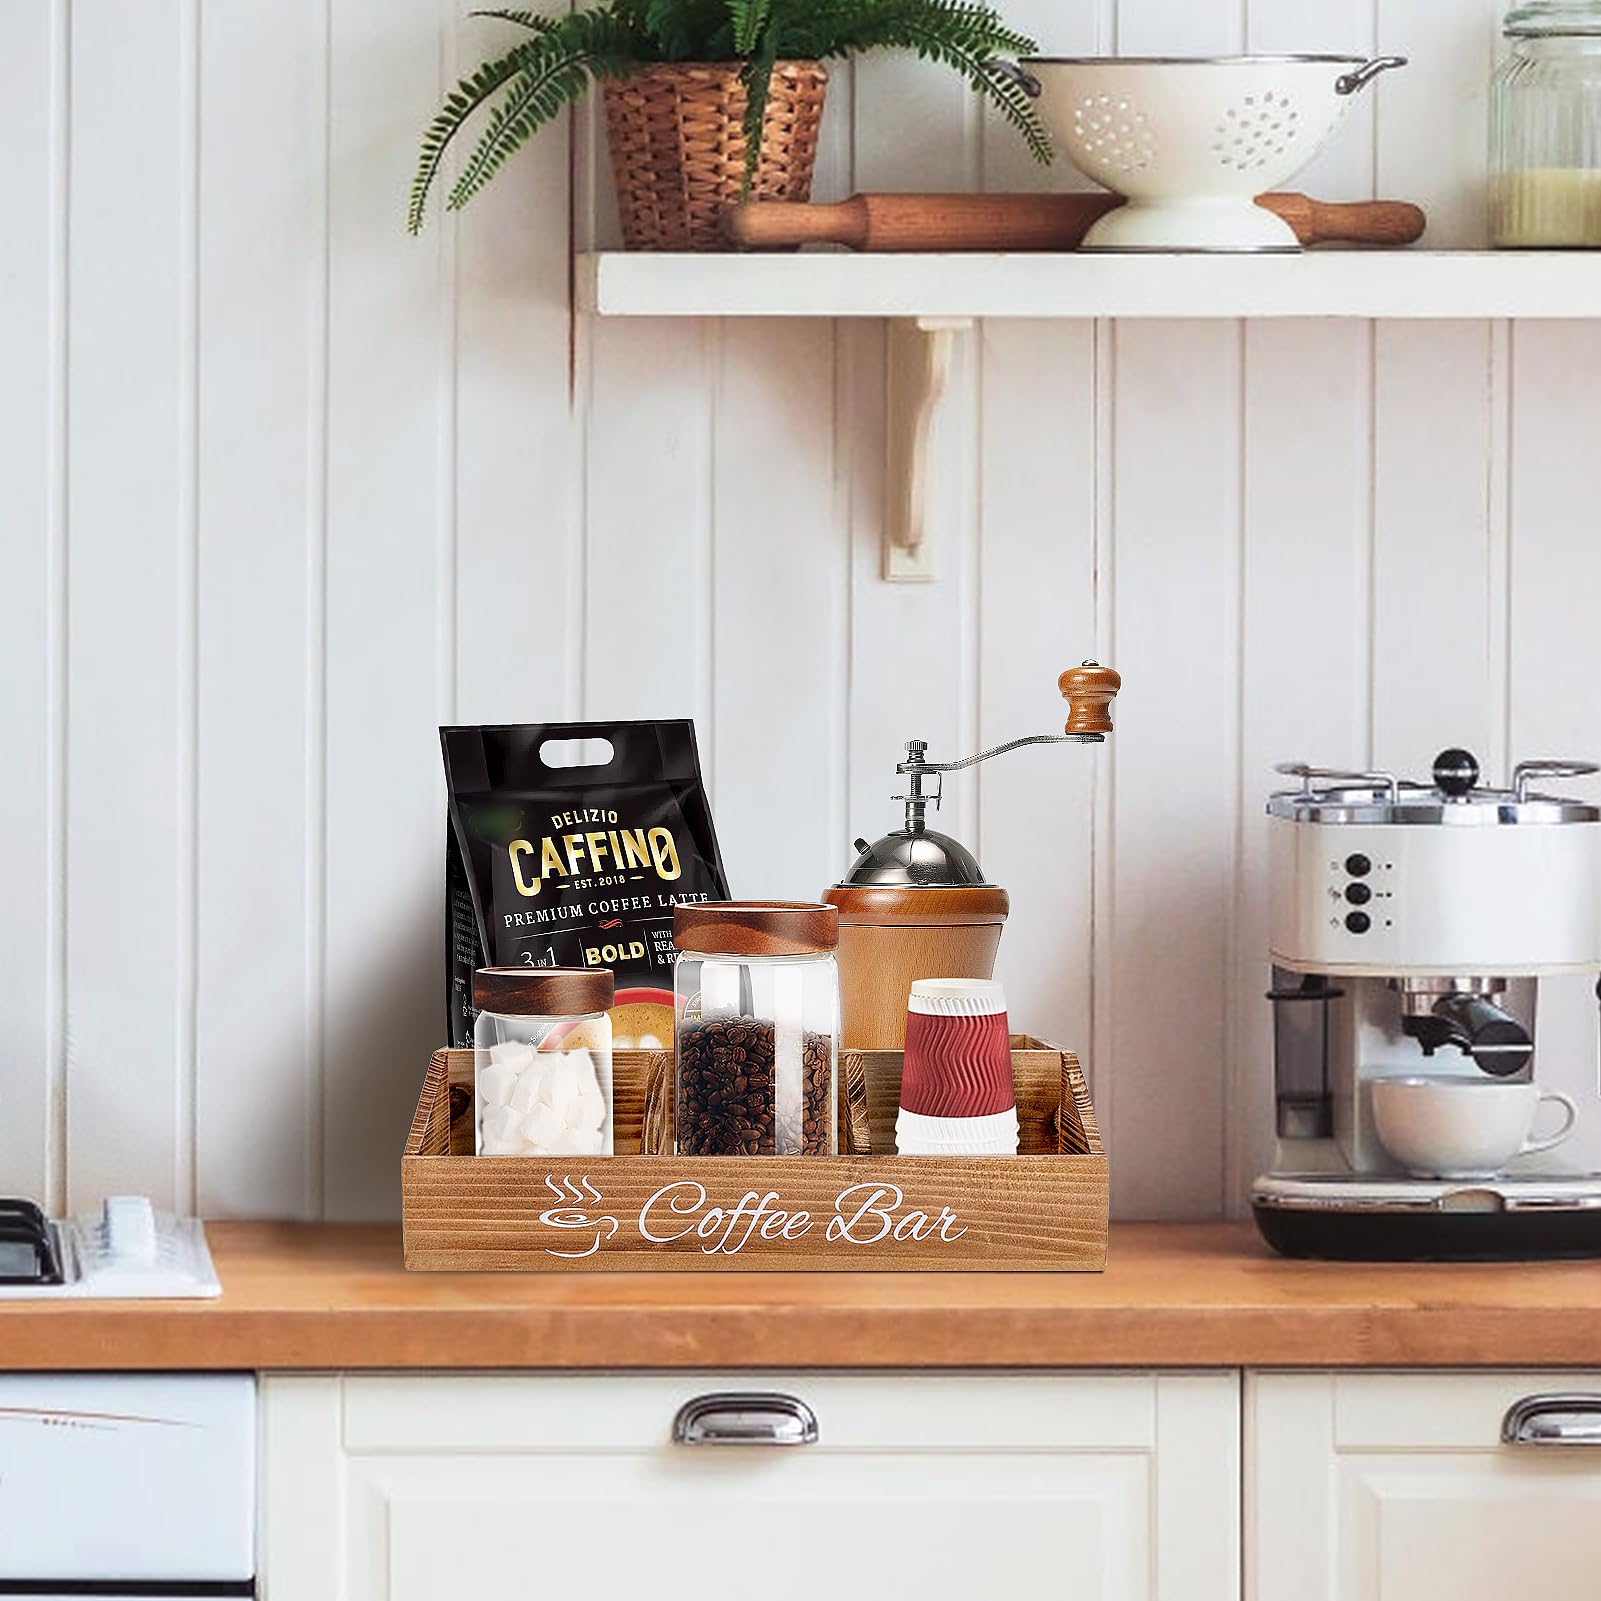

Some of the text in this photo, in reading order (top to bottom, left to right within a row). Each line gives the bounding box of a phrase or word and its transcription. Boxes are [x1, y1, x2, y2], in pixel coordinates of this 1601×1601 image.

[551, 808, 618, 830] DELIZIO
[508, 827, 682, 897] CAFFINO
[503, 904, 584, 928] PREMIUM
[588, 896, 652, 915] COFFEE
[585, 941, 645, 965] BOLD
[638, 1181, 969, 1255] Coffee Bar
